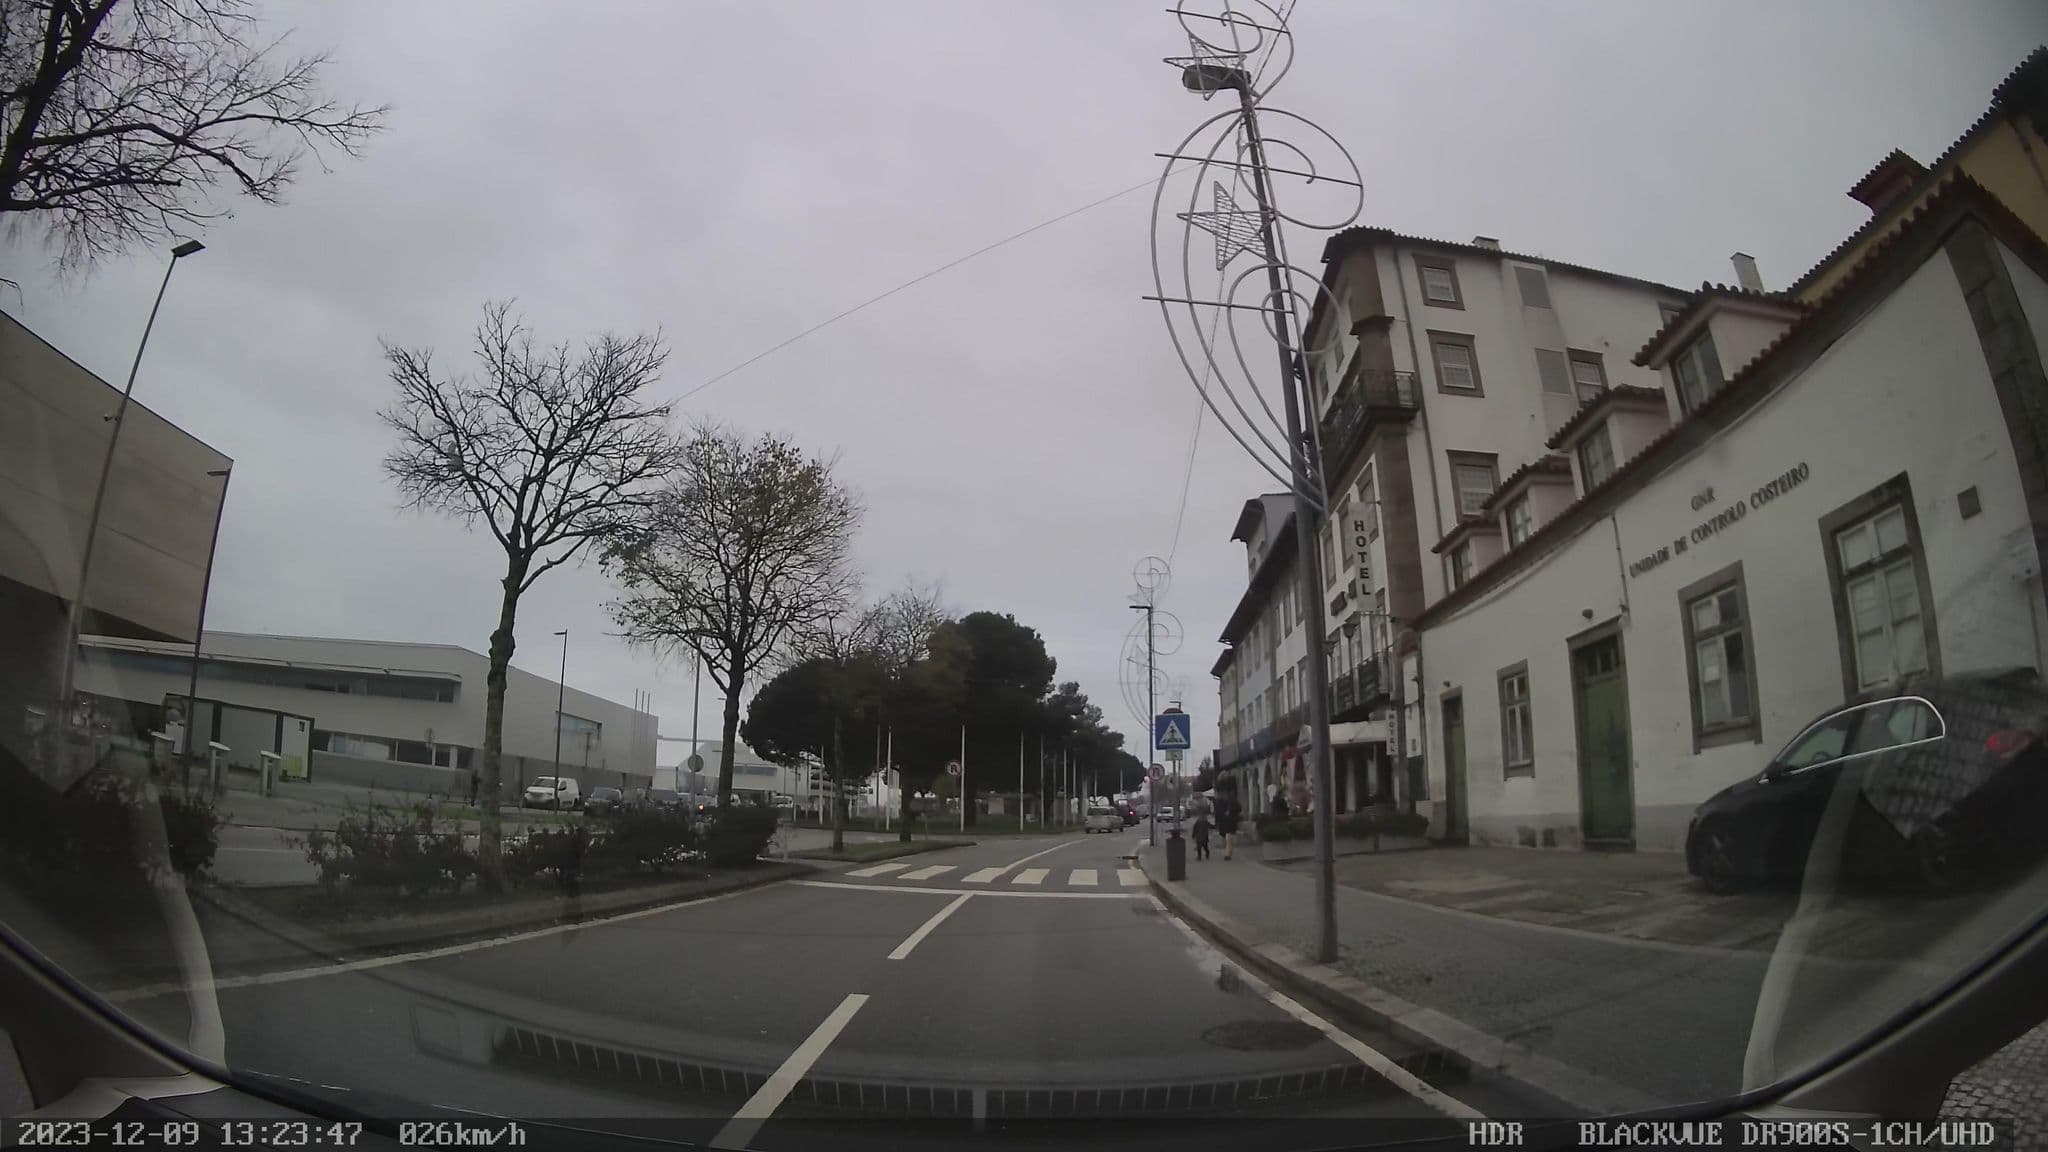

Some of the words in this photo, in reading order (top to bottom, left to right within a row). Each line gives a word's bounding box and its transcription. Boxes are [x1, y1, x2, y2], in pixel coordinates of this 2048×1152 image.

[1354, 520, 1371, 596] HOTEL
[1629, 546, 1669, 578] UNIDADE
[1674, 536, 1688, 555] DE
[1691, 500, 1746, 544] CONTROLO
[1750, 461, 1809, 509] COSTEIRO
